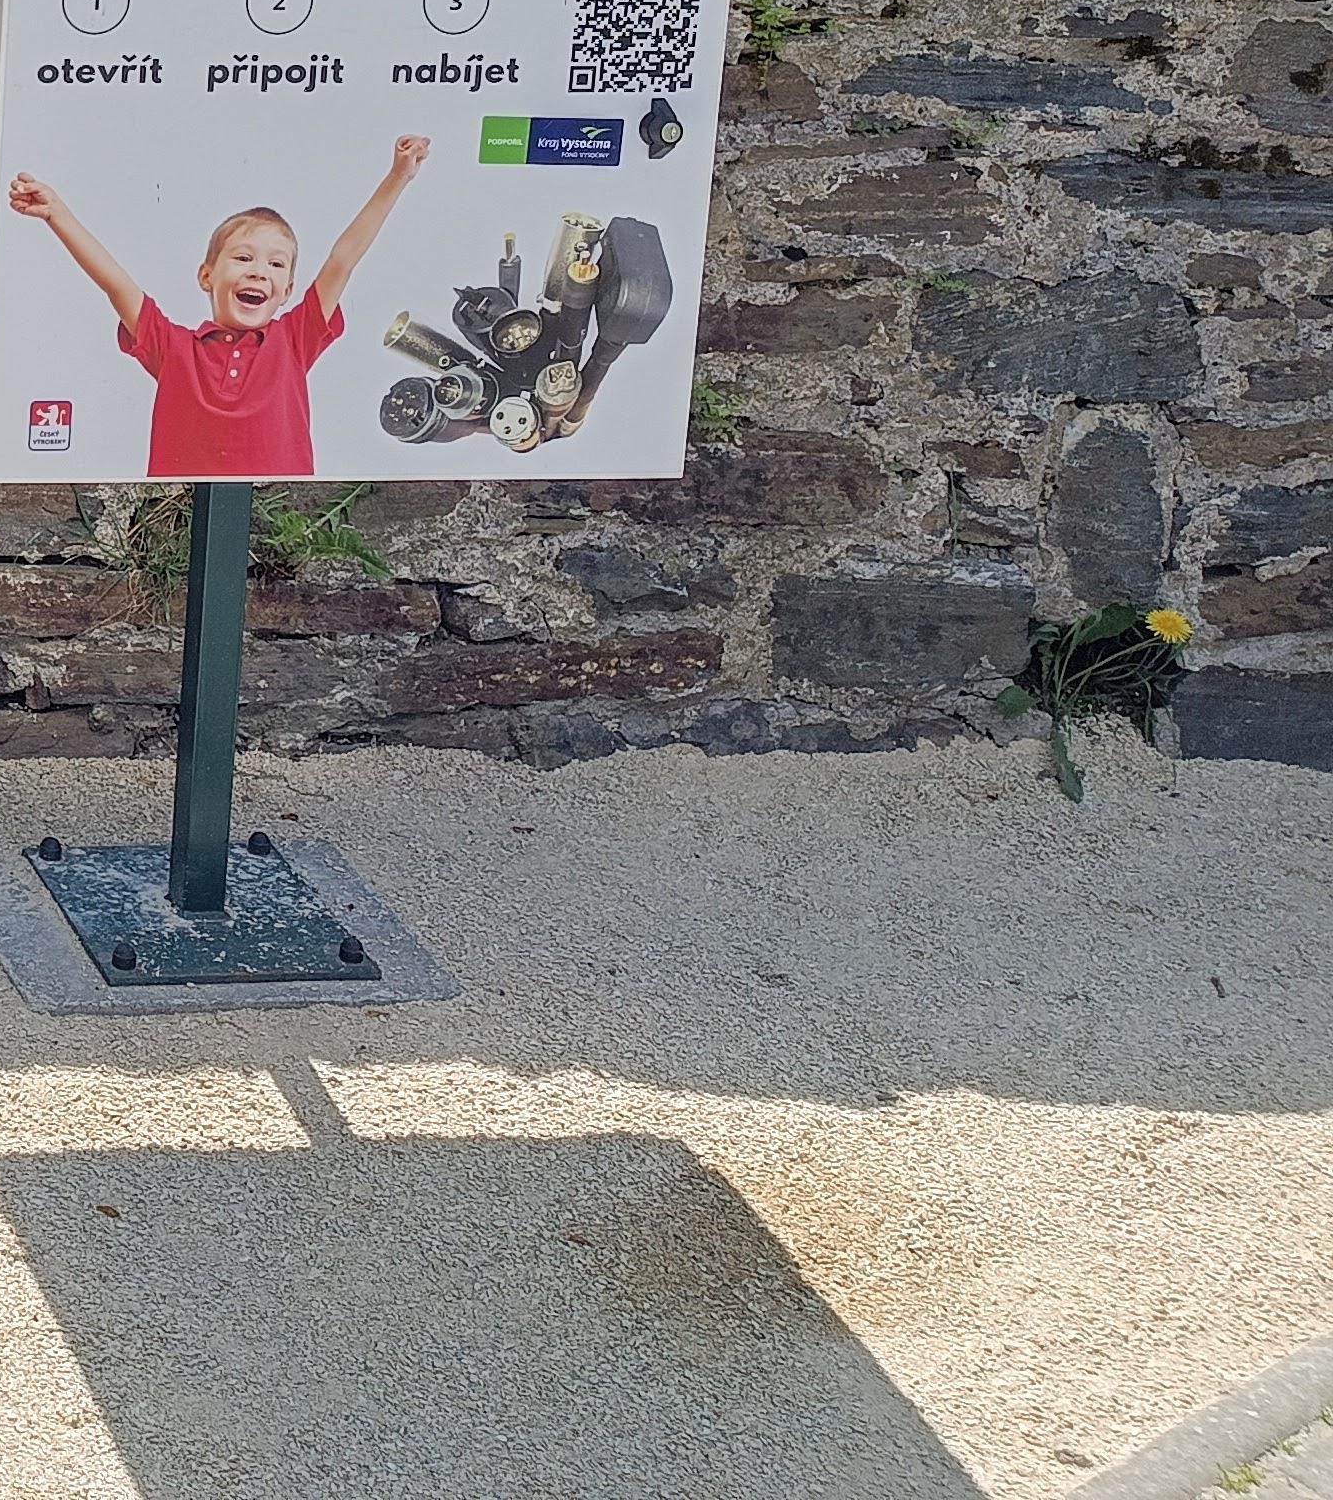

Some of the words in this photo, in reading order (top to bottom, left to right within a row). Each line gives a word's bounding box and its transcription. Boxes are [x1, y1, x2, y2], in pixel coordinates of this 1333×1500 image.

[37, 53, 163, 84] otevřít
[207, 54, 345, 92] připojit
[391, 53, 520, 92] nabíjet
[537, 138, 560, 151] Kraj
